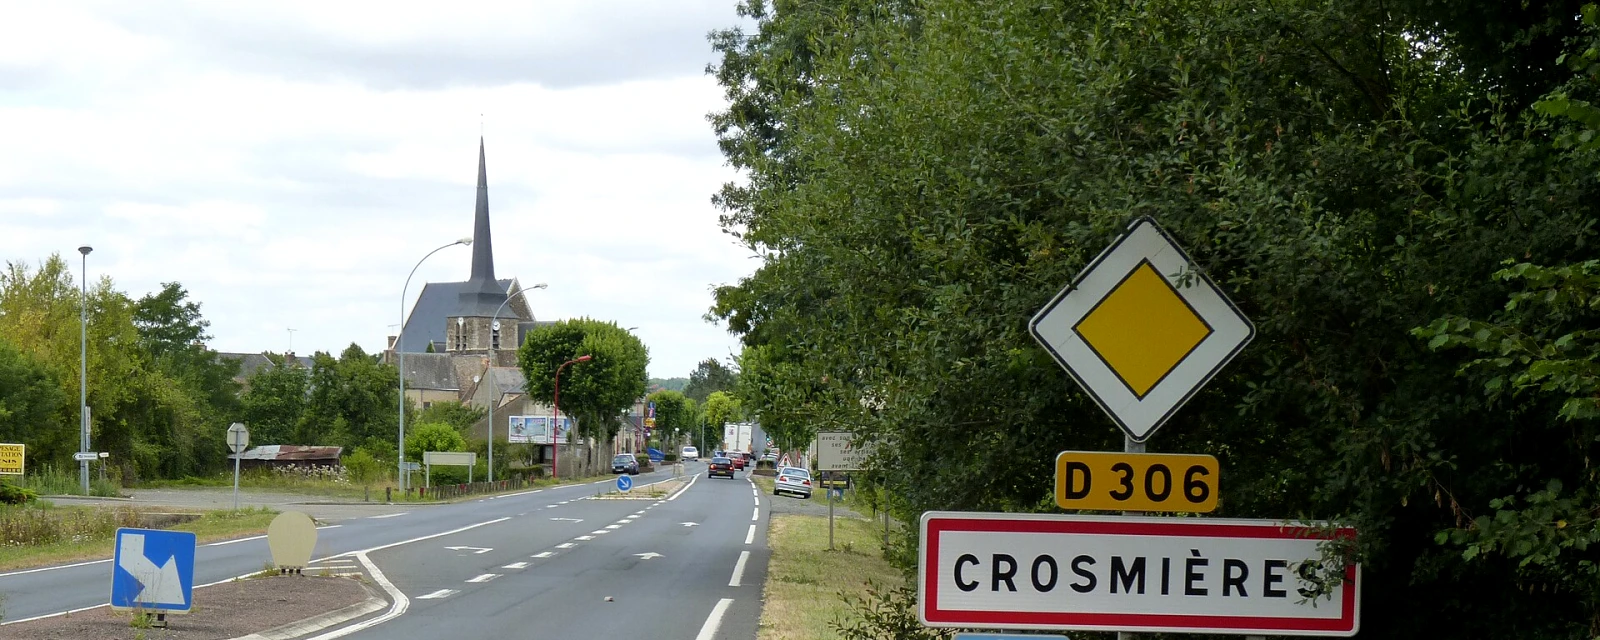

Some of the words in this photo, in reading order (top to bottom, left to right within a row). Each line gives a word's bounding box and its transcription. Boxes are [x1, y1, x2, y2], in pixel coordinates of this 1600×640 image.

[1065, 461, 1092, 500] D
[1109, 462, 1210, 503] 306
[953, 549, 1324, 598] CROSMIÈRES
